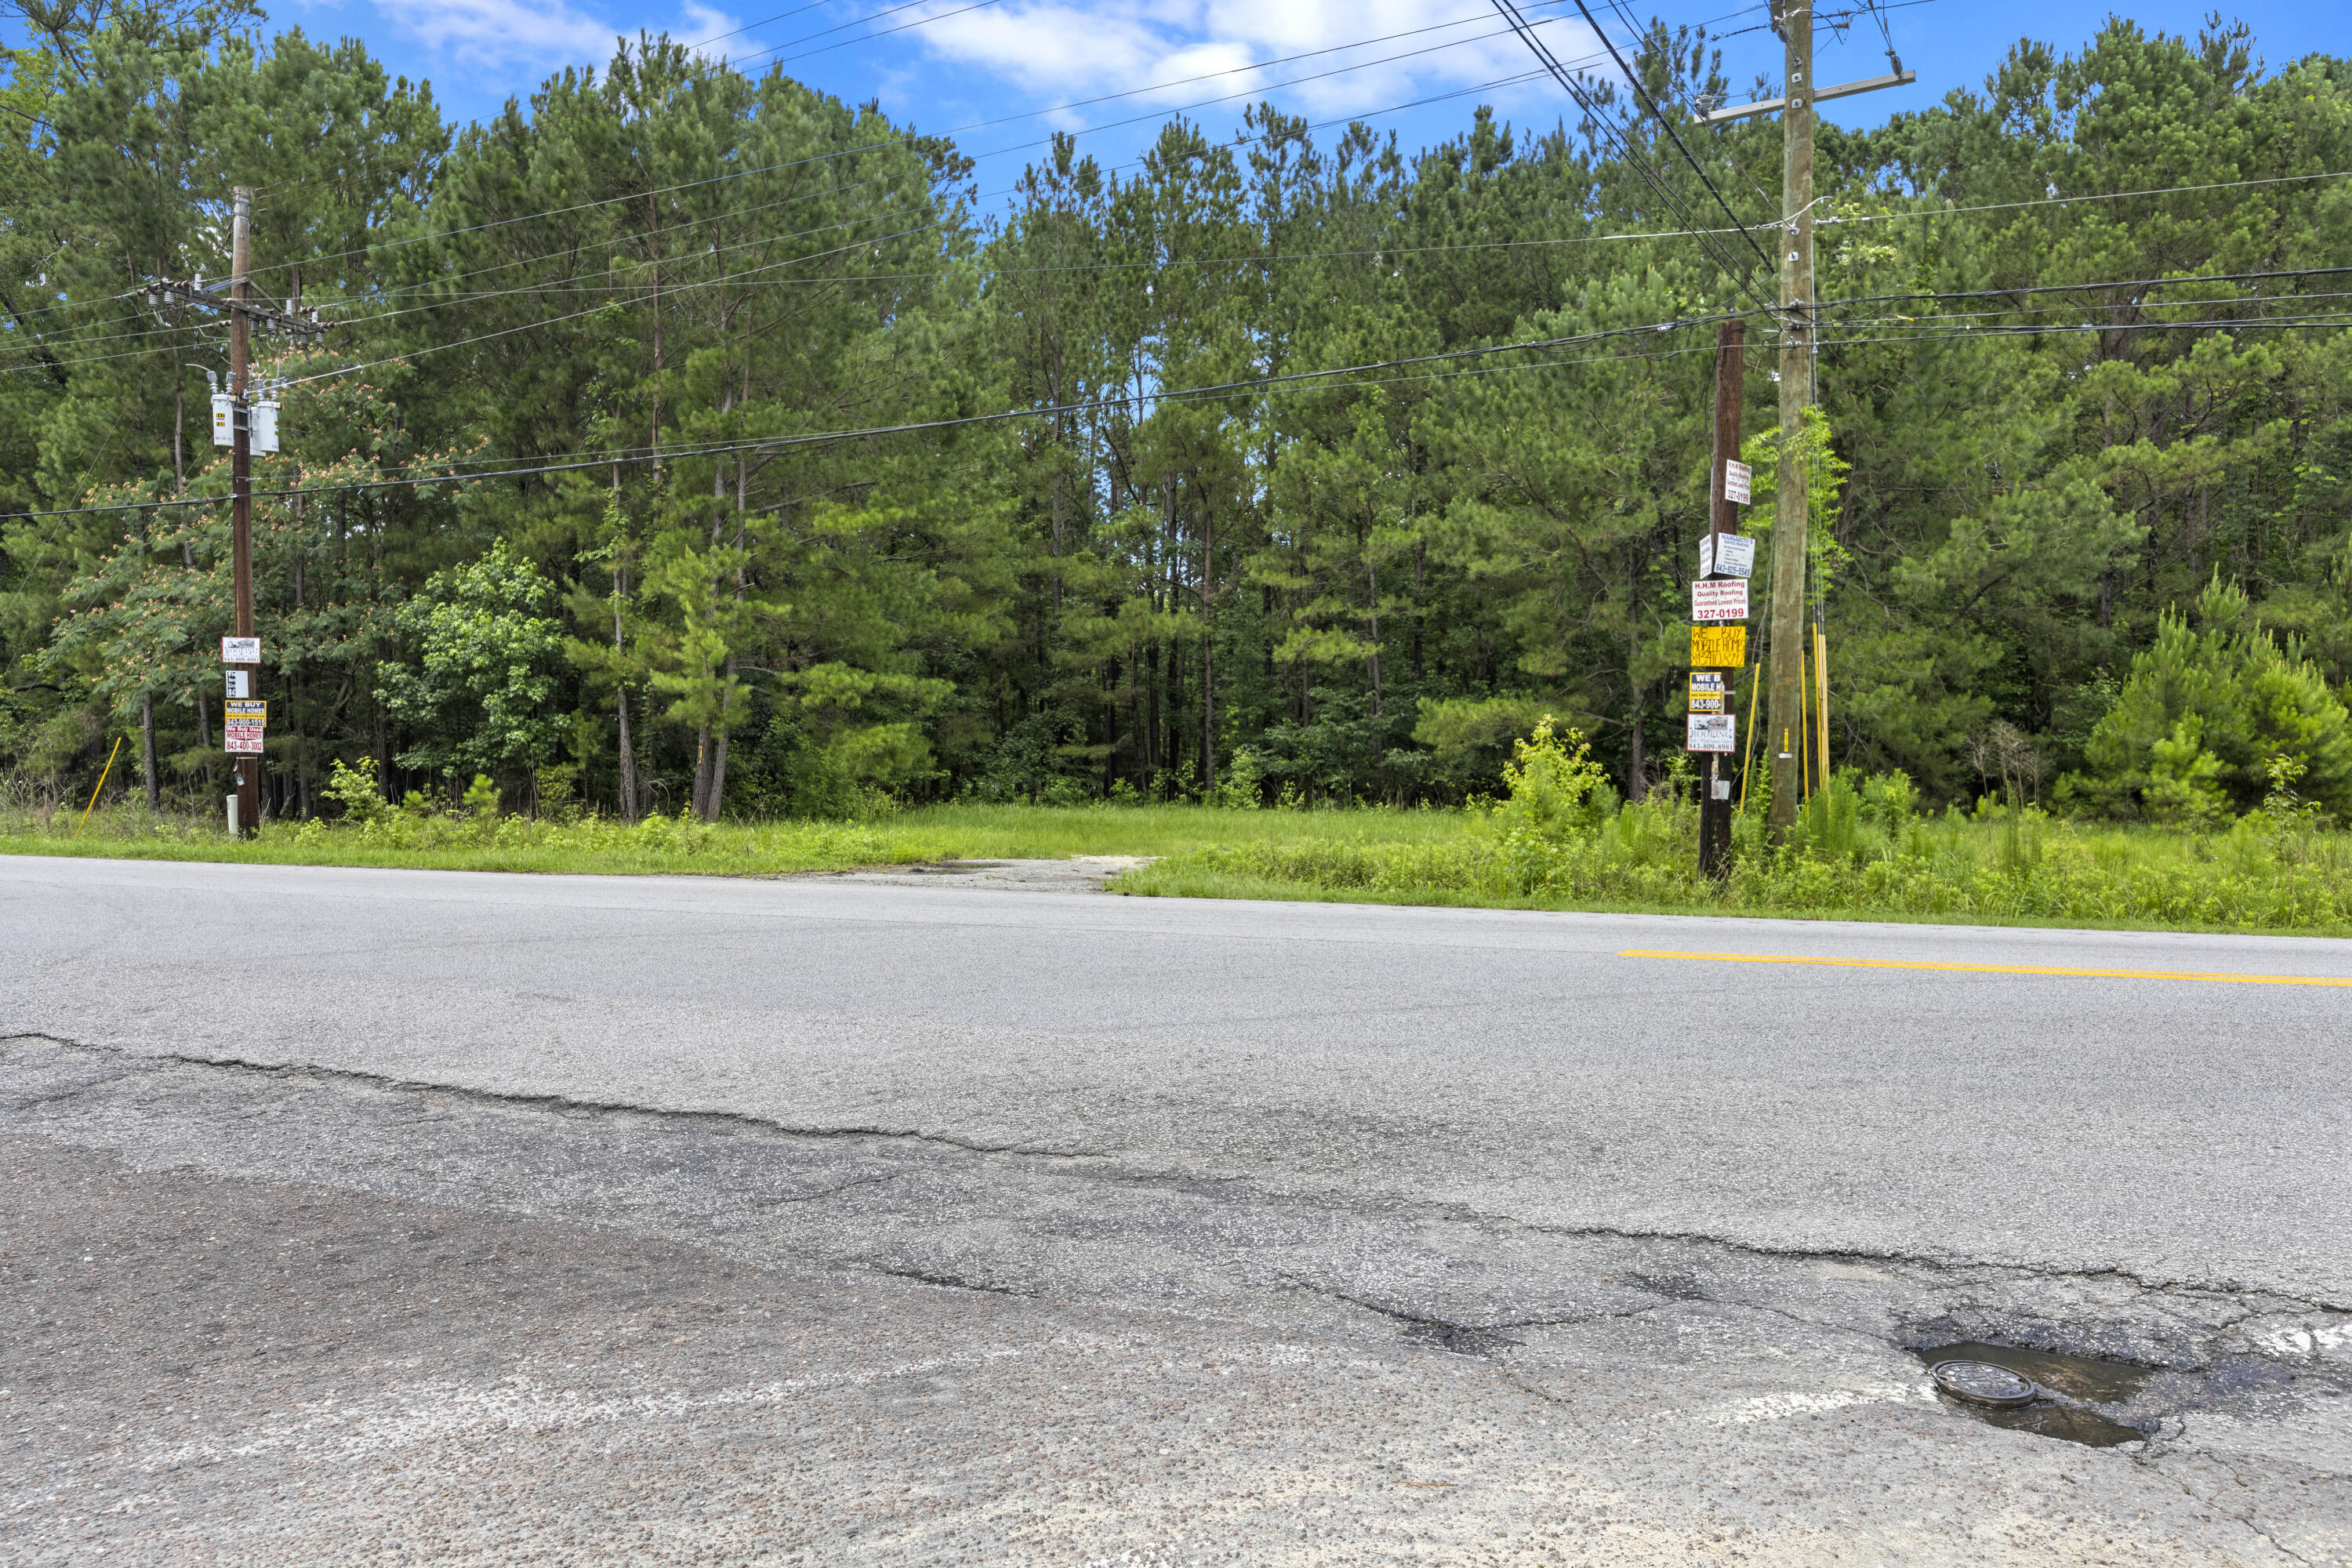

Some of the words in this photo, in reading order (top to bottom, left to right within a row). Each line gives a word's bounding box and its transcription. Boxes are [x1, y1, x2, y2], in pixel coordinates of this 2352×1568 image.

[1727, 488, 1748, 503] 327-0199
[1715, 563, 1751, 577] 843-925-5545
[1697, 608, 1744, 619] 327-0199
[1693, 627, 1708, 639] WE
[1692, 639, 1721, 653] MOBILE
[1691, 683, 1715, 691] MOBILE
[1690, 729, 1731, 739] ROOFING
[227, 741, 262, 750] 843-400-3002
